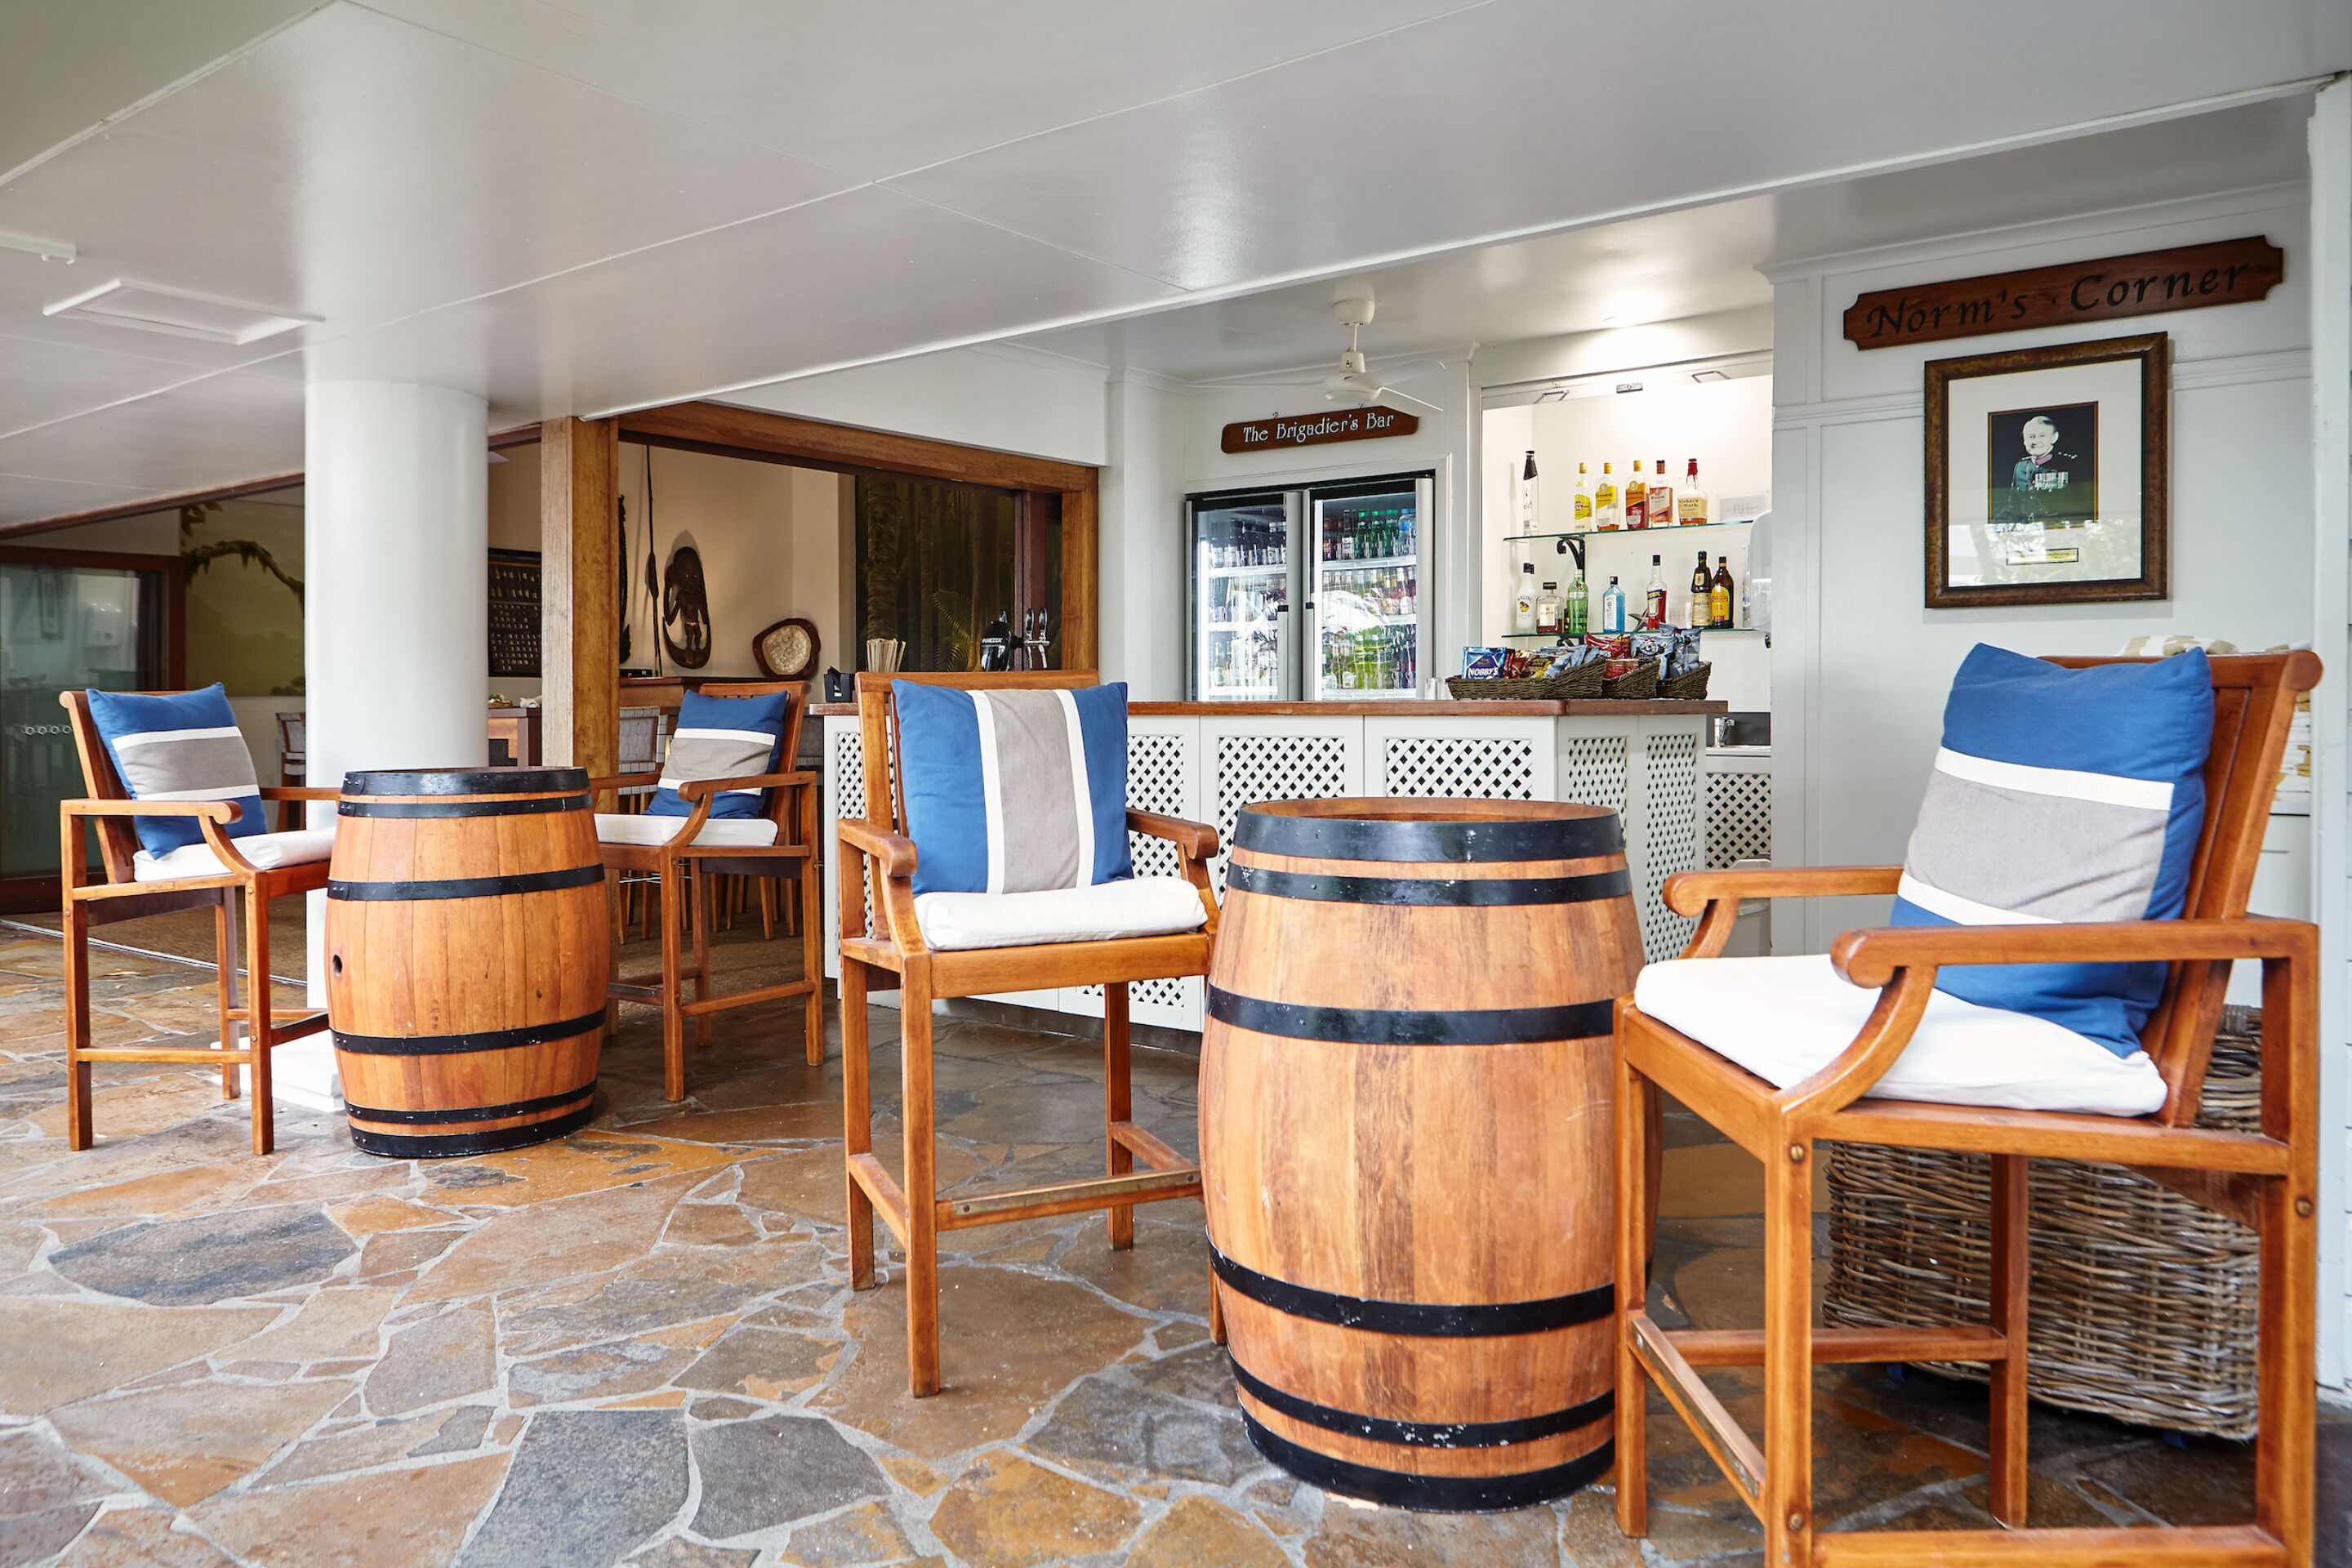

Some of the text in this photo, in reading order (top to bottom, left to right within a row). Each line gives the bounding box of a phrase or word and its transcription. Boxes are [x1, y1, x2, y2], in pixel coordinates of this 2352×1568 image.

[1866, 263, 2249, 337] Norm's Corner
[1243, 412, 1394, 443] The Brigadier's Bar
[1468, 667, 1499, 676] NOBBY'S
